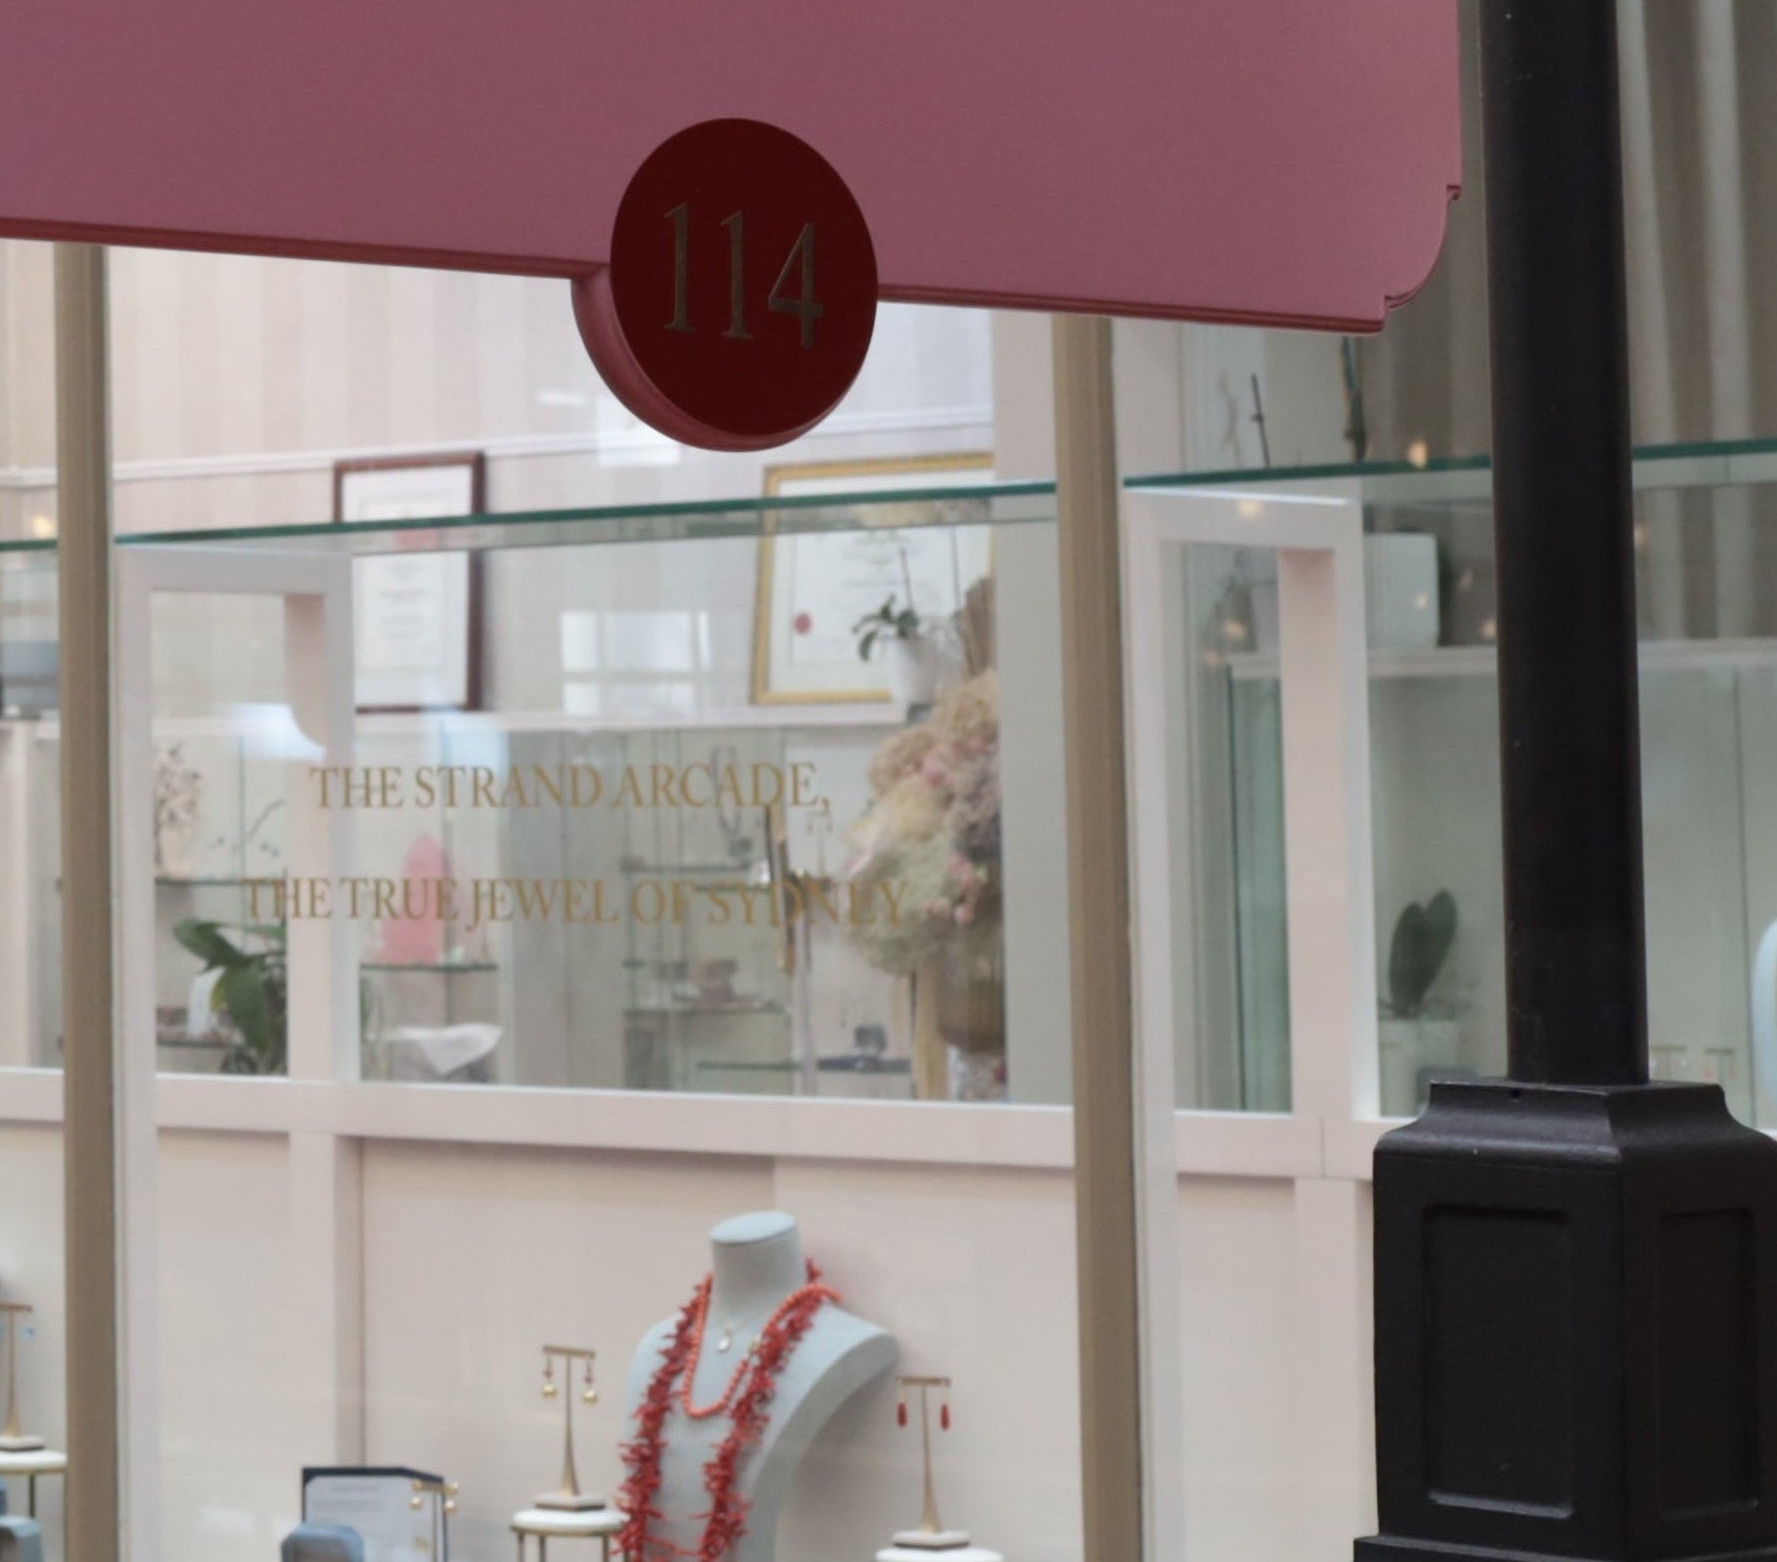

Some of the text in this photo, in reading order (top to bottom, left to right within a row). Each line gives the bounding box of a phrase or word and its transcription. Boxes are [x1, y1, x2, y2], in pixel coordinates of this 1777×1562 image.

[664, 201, 826, 350] 114
[309, 762, 831, 815] THE STRAND ARCADE,
[242, 877, 333, 920] THE
[339, 877, 461, 921] TRUE
[465, 878, 619, 933] JEWEL
[630, 880, 694, 925] OF
